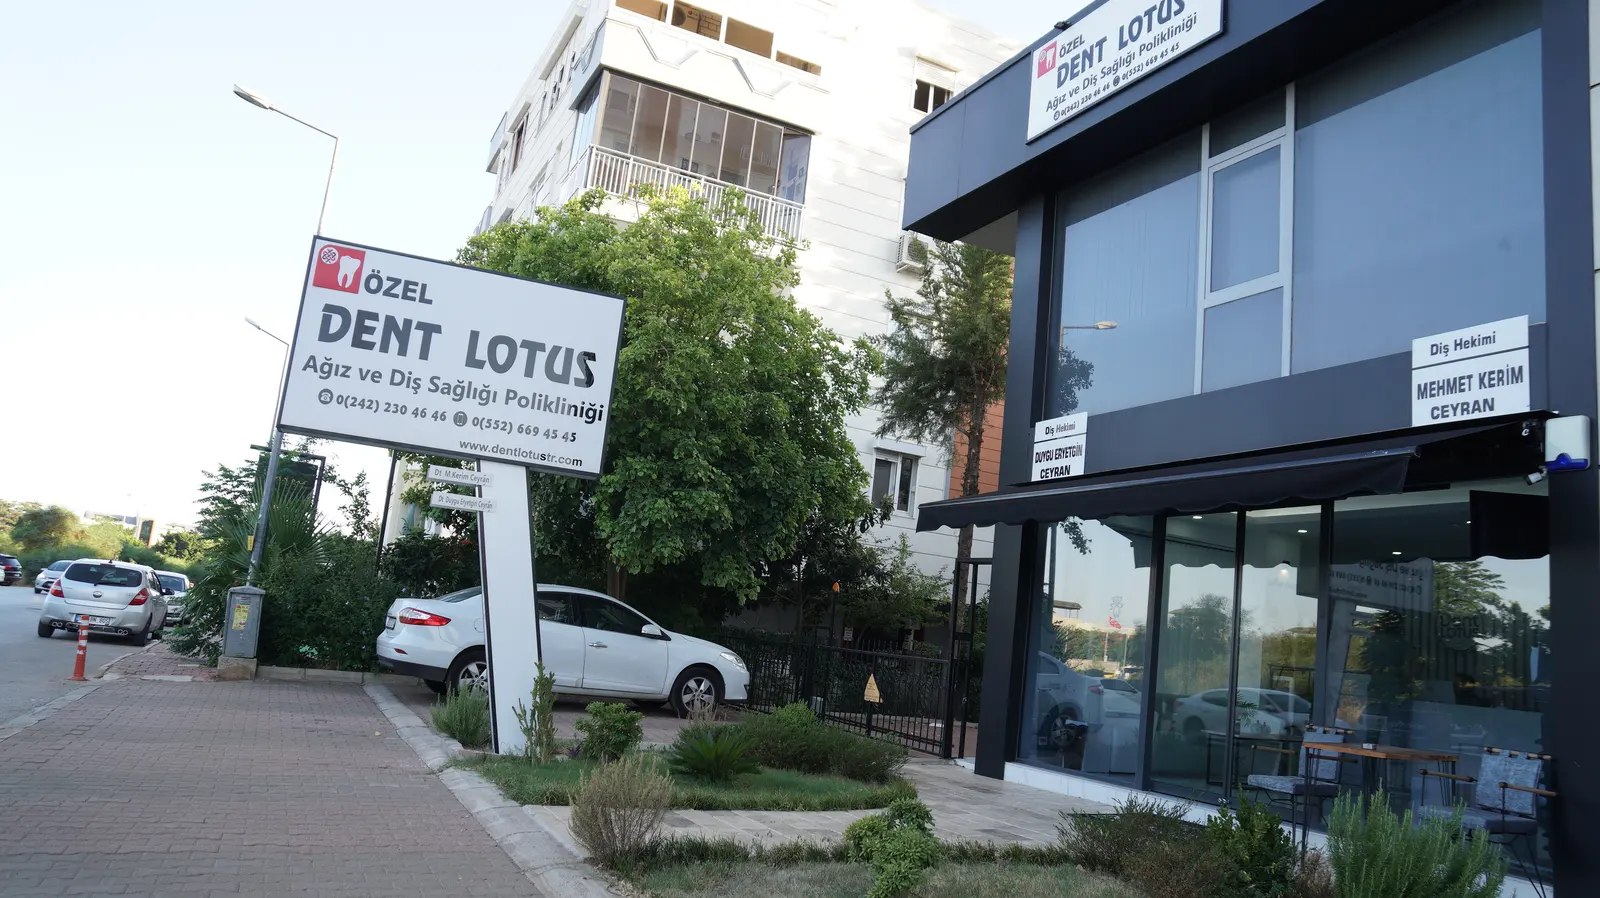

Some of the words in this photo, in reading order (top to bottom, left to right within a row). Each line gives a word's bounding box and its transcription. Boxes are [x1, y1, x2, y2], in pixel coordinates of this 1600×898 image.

[1046, 93, 1067, 112] Ağız
[1068, 85, 1080, 98] ve
[1082, 74, 1098, 90] Diş
[1100, 50, 1136, 79] Sağlığı
[1139, 12, 1197, 56] Polikliniği
[1056, 35, 1108, 89] DENT
[1059, 34, 1086, 58] ÖZEL
[1060, 101, 1080, 117] 0(242)
[1081, 93, 1093, 105] 230
[1093, 87, 1101, 98] 46
[1102, 82, 1110, 92] 46
[1121, 62, 1144, 81] 0(552)
[1145, 55, 1158, 67] 669
[1160, 49, 1168, 59] 45
[1170, 42, 1179, 53] 45
[364, 268, 433, 305] ÖZEL
[317, 303, 442, 361] DENT
[464, 329, 597, 389] LOTUS
[1430, 342, 1450, 357] Diş
[1454, 331, 1496, 351] Hekimi
[302, 354, 352, 380] Ağız
[358, 367, 383, 384] ve
[389, 368, 422, 395] Diş
[427, 375, 498, 406] Sağlığı
[504, 388, 604, 425] Polikliniği
[1417, 374, 1473, 400] MEHMET
[1478, 363, 1523, 390] KERİM
[336, 394, 380, 413] 0(242)
[383, 402, 408, 416] 230
[411, 407, 427, 419] 46
[430, 410, 447, 422] 46
[471, 416, 513, 435] 0(552)
[517, 423, 539, 437] 669
[542, 429, 558, 440] 45
[562, 432, 577, 443] 45
[1430, 397, 1495, 420] CEYRAN
[1045, 426, 1055, 437] Diş
[1055, 421, 1076, 433] Hekimi
[459, 440, 583, 467] www.dentlotustr.com
[1035, 448, 1054, 464] DUYGU
[1040, 464, 1071, 479] CEYRAN
